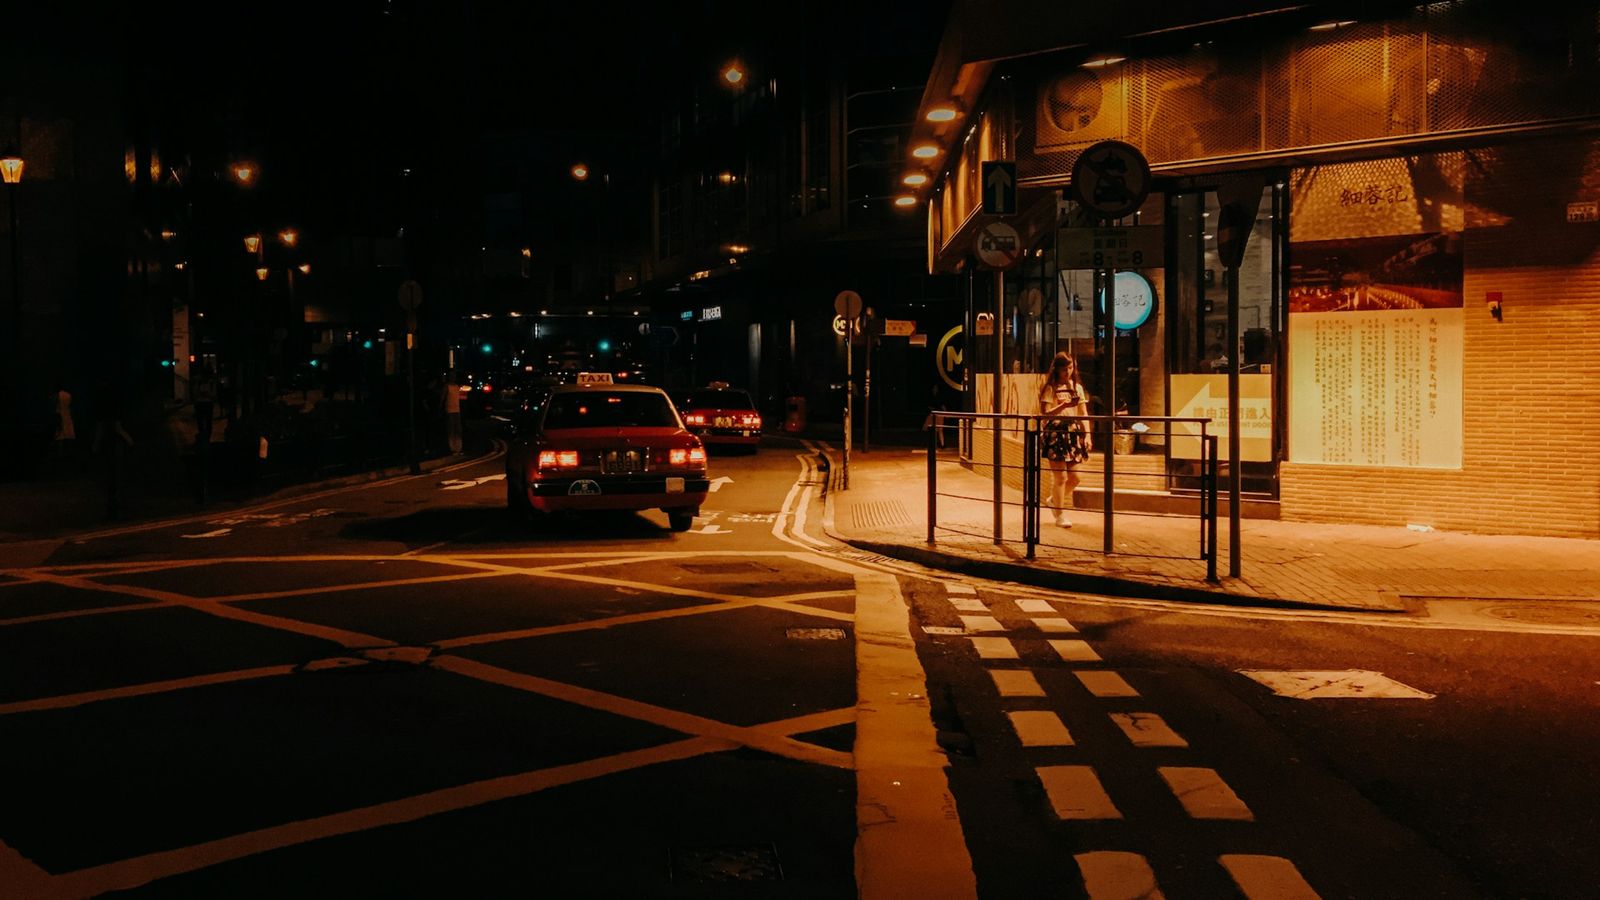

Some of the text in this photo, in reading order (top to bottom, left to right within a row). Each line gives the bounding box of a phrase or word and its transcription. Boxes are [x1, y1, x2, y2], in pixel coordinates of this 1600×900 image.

[1340, 184, 1407, 207] 細蓉記
[580, 374, 610, 383] TAXI
